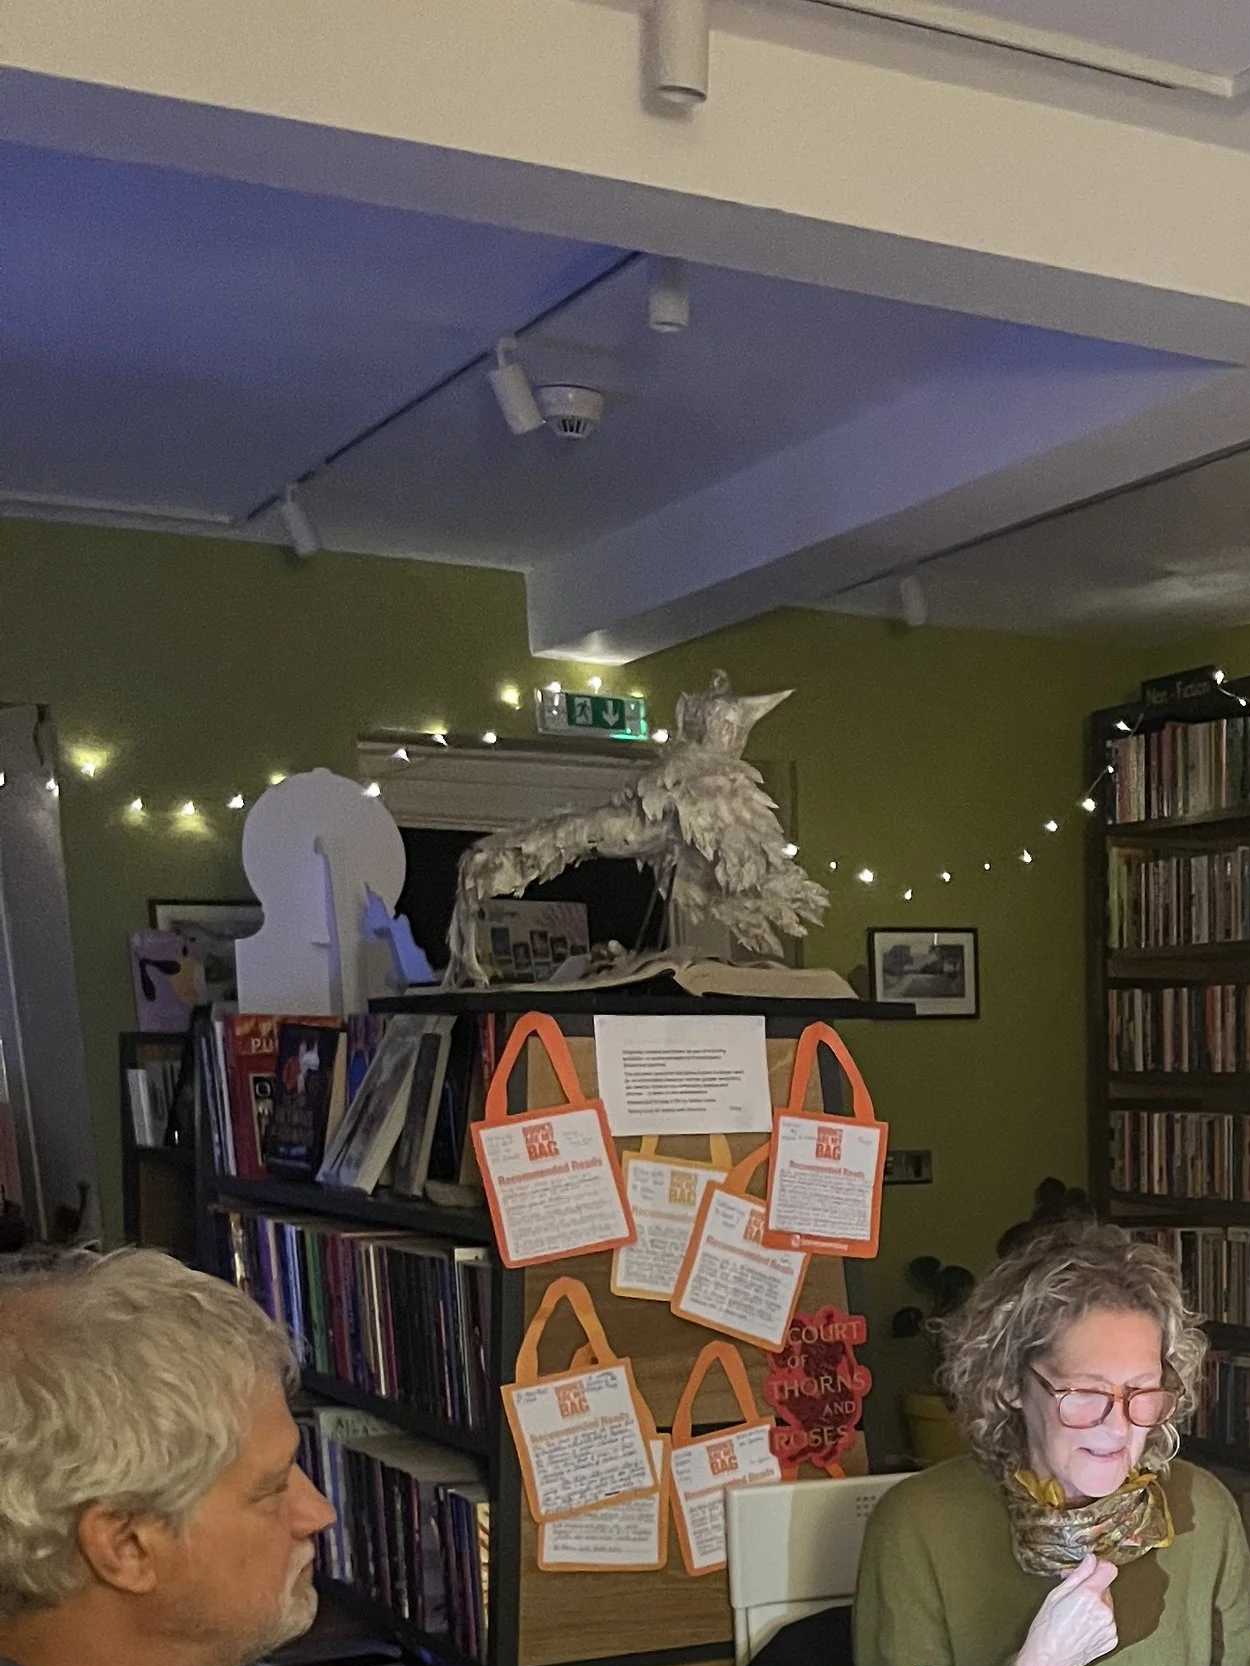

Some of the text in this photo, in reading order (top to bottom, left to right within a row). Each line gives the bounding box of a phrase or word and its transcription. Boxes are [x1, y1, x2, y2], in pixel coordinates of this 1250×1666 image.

[527, 1141, 560, 1162] BAG
[816, 1143, 841, 1161] BAG
[498, 1163, 570, 1186] Recommended
[788, 1321, 862, 1345] COURT
[787, 1354, 809, 1369] OF
[767, 1371, 866, 1400] THORNS
[561, 1399, 591, 1419] BAG
[822, 1400, 856, 1417] AND
[773, 1425, 851, 1452] ROSES
[709, 1456, 739, 1476] BAG
